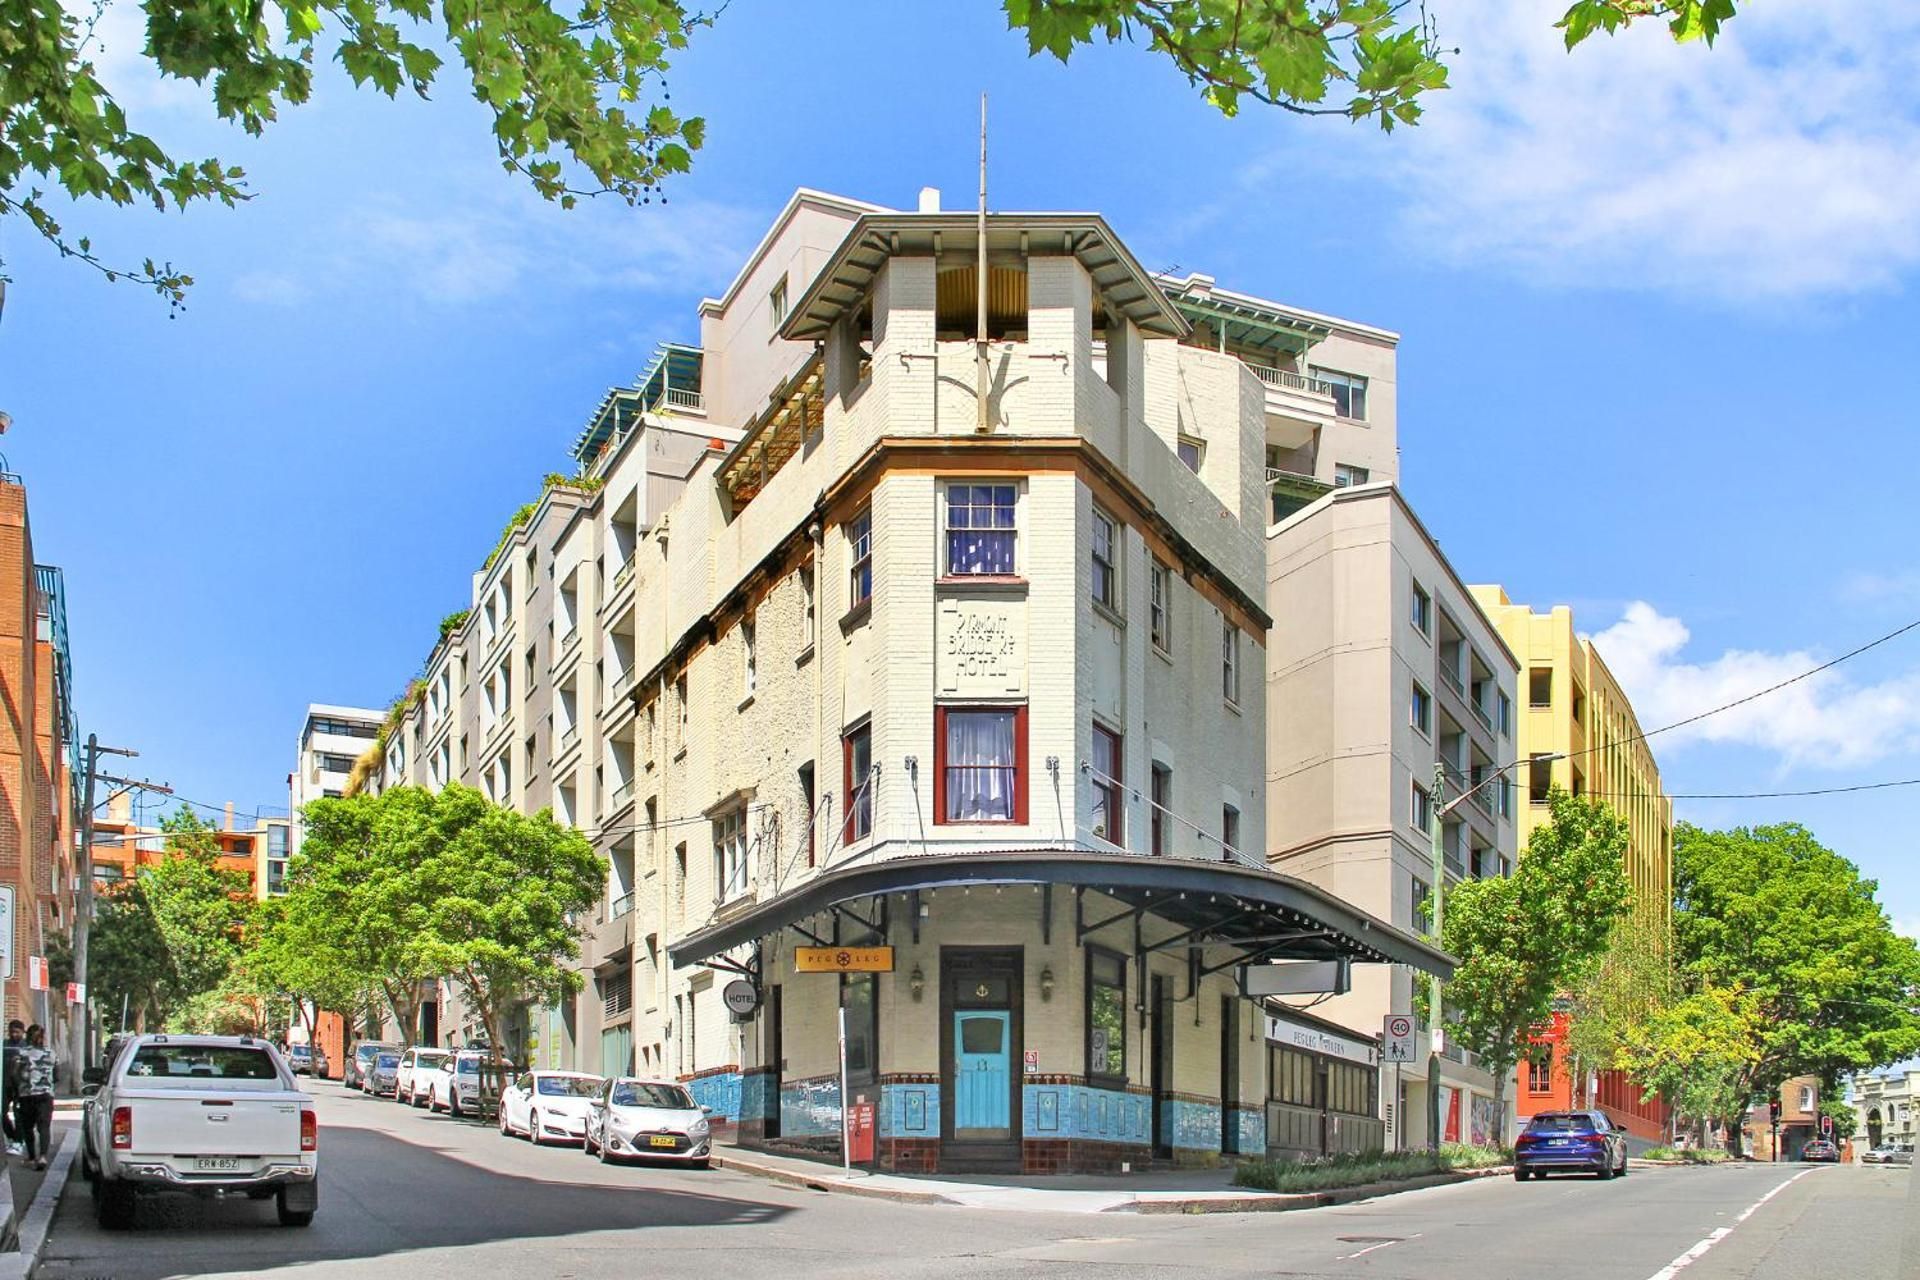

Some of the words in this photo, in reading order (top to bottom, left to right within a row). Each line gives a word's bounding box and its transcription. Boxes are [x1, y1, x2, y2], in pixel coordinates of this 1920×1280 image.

[955, 656, 1008, 677] HOTEL
[729, 994, 754, 1003] HOTEL
[1393, 1023, 1407, 1033] 40
[1319, 1033, 1345, 1056] TVERN
